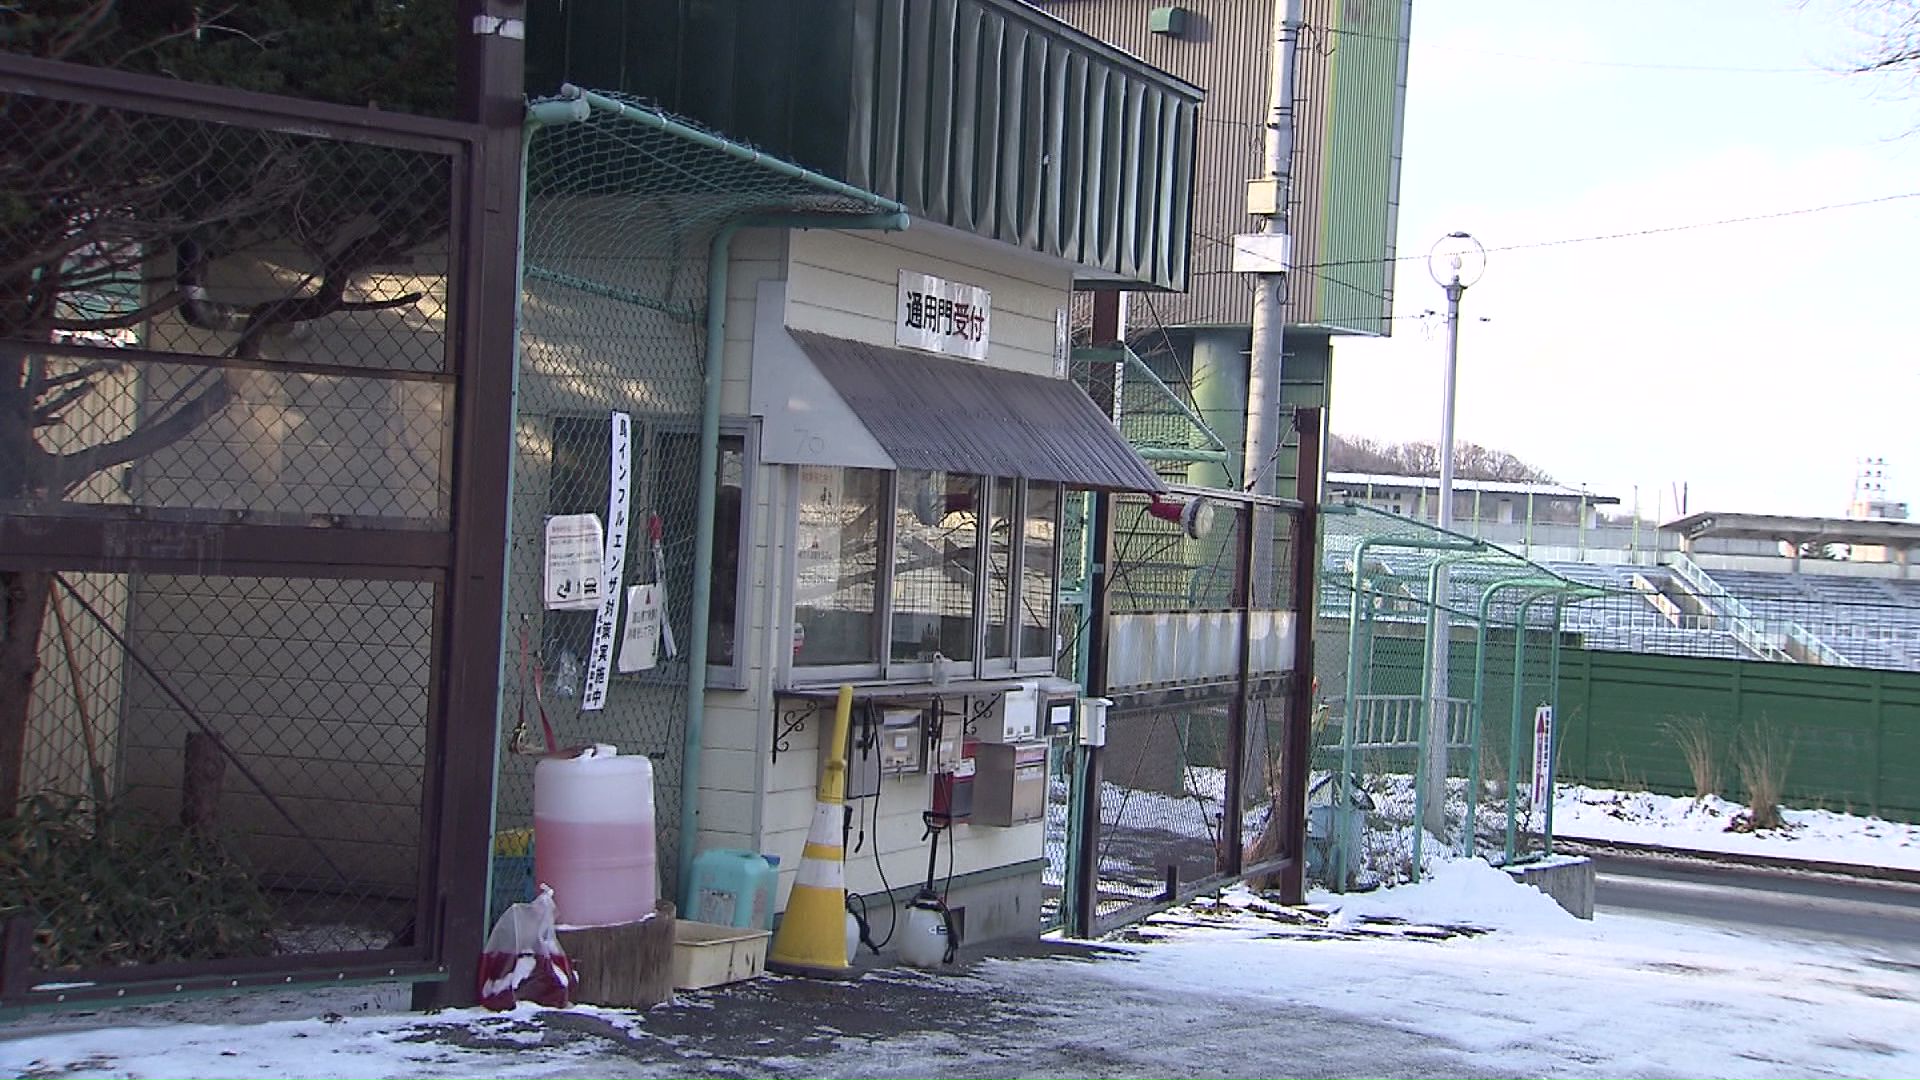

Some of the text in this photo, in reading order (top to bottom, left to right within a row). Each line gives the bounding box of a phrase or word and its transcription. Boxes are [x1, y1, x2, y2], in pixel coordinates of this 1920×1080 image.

[905, 291, 985, 343] 通用門受付
